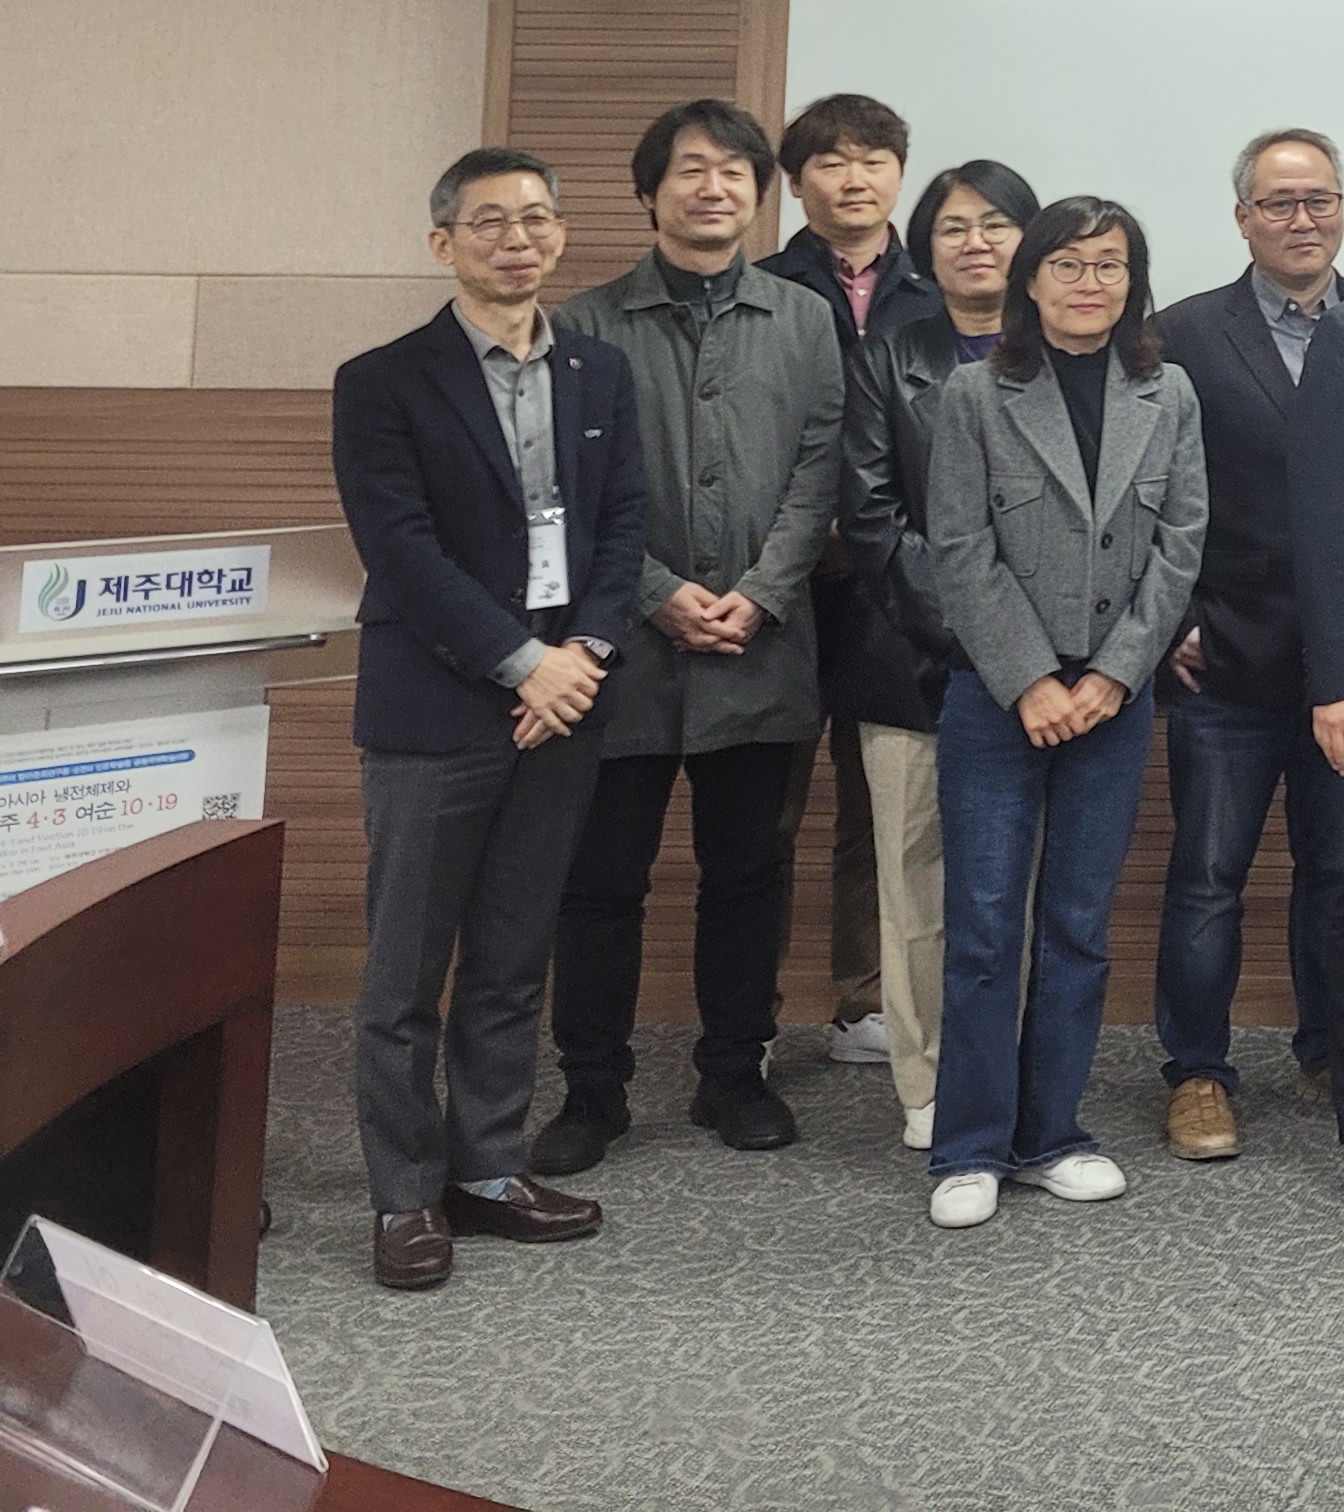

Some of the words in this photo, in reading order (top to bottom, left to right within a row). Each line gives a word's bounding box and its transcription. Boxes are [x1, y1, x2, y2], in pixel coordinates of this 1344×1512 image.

[98, 567, 254, 603] 제주대학교
[96, 607, 122, 618] JEJU
[126, 600, 182, 615] NATIONAL
[187, 596, 252, 611] UNIVERSITY
[54, 778, 132, 803] 냉전체제와
[26, 808, 66, 830] 4·3
[75, 801, 117, 822] 여순
[121, 792, 179, 816] 10·19
